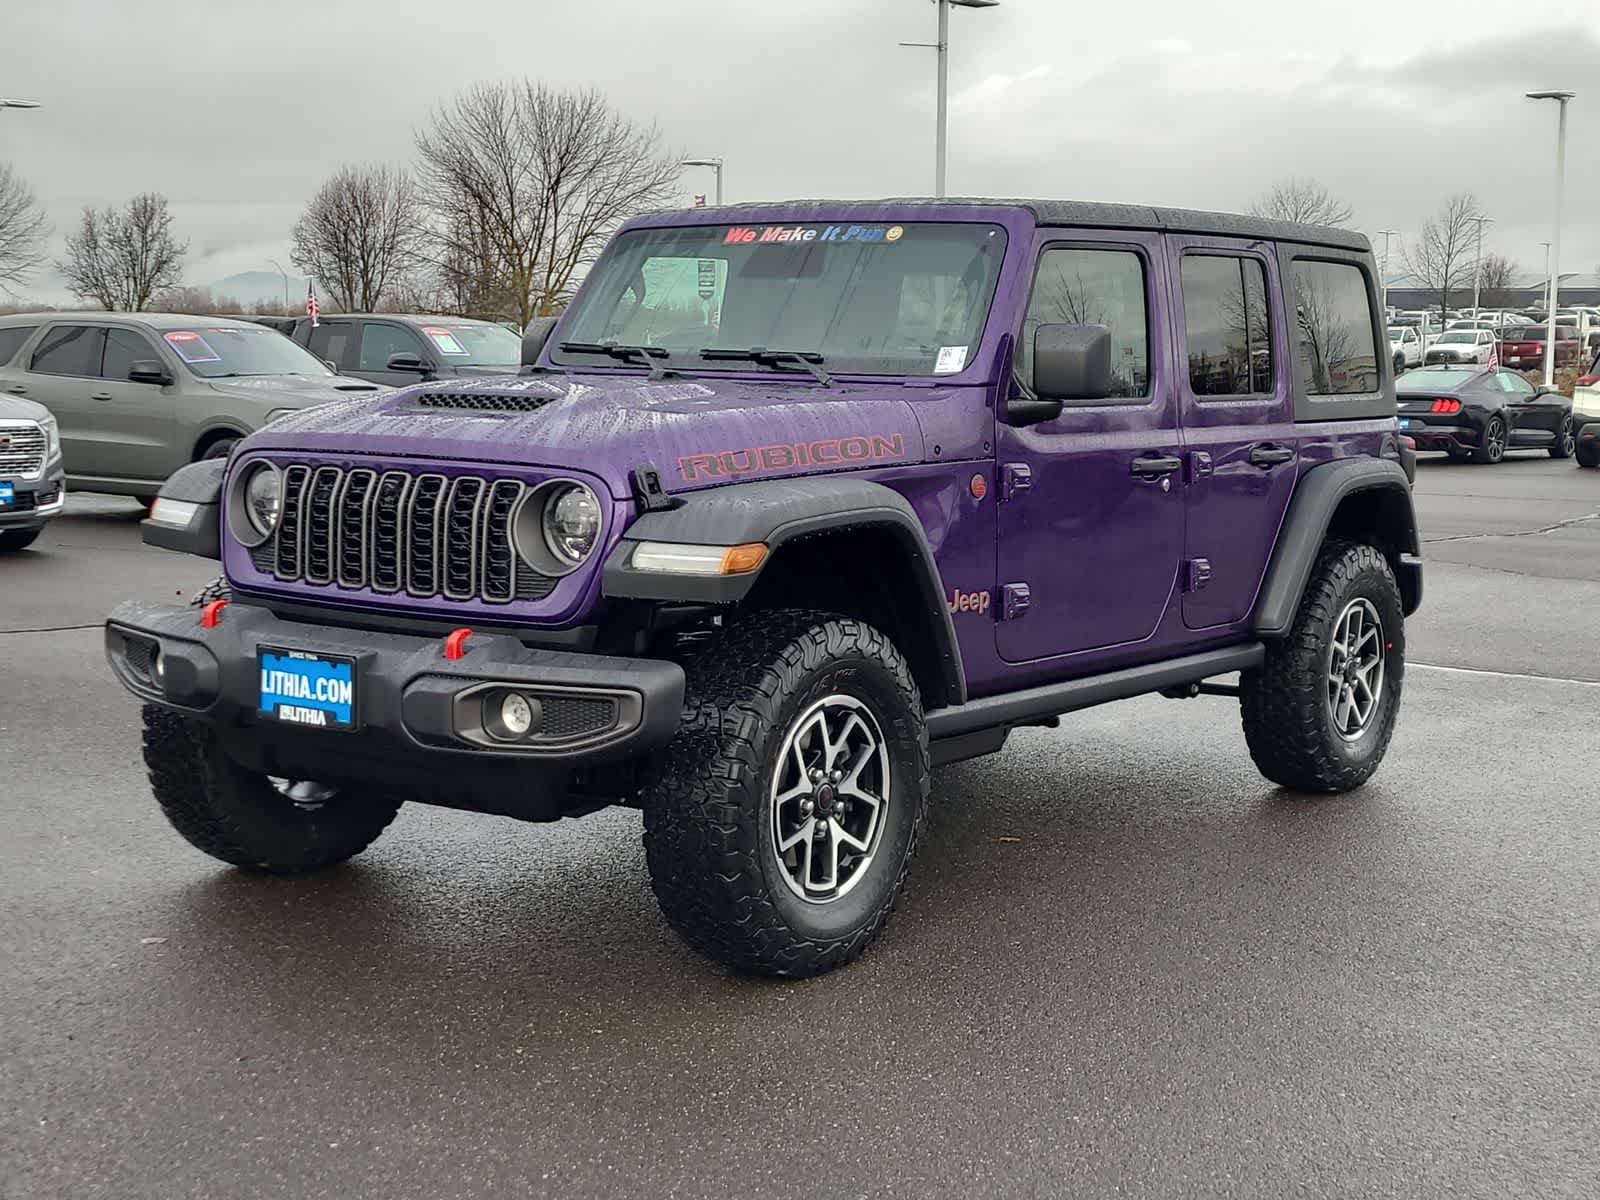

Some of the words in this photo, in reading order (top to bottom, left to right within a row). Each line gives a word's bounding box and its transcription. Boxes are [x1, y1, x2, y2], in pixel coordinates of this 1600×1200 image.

[724, 227, 756, 243] We
[760, 226, 817, 242] Make
[820, 226, 837, 240] It
[842, 225, 885, 241] Fun
[679, 433, 904, 481] RUBICON
[947, 589, 990, 615] Jeep
[261, 668, 352, 705] LITHIA.COM
[291, 706, 326, 726] LITHIA
